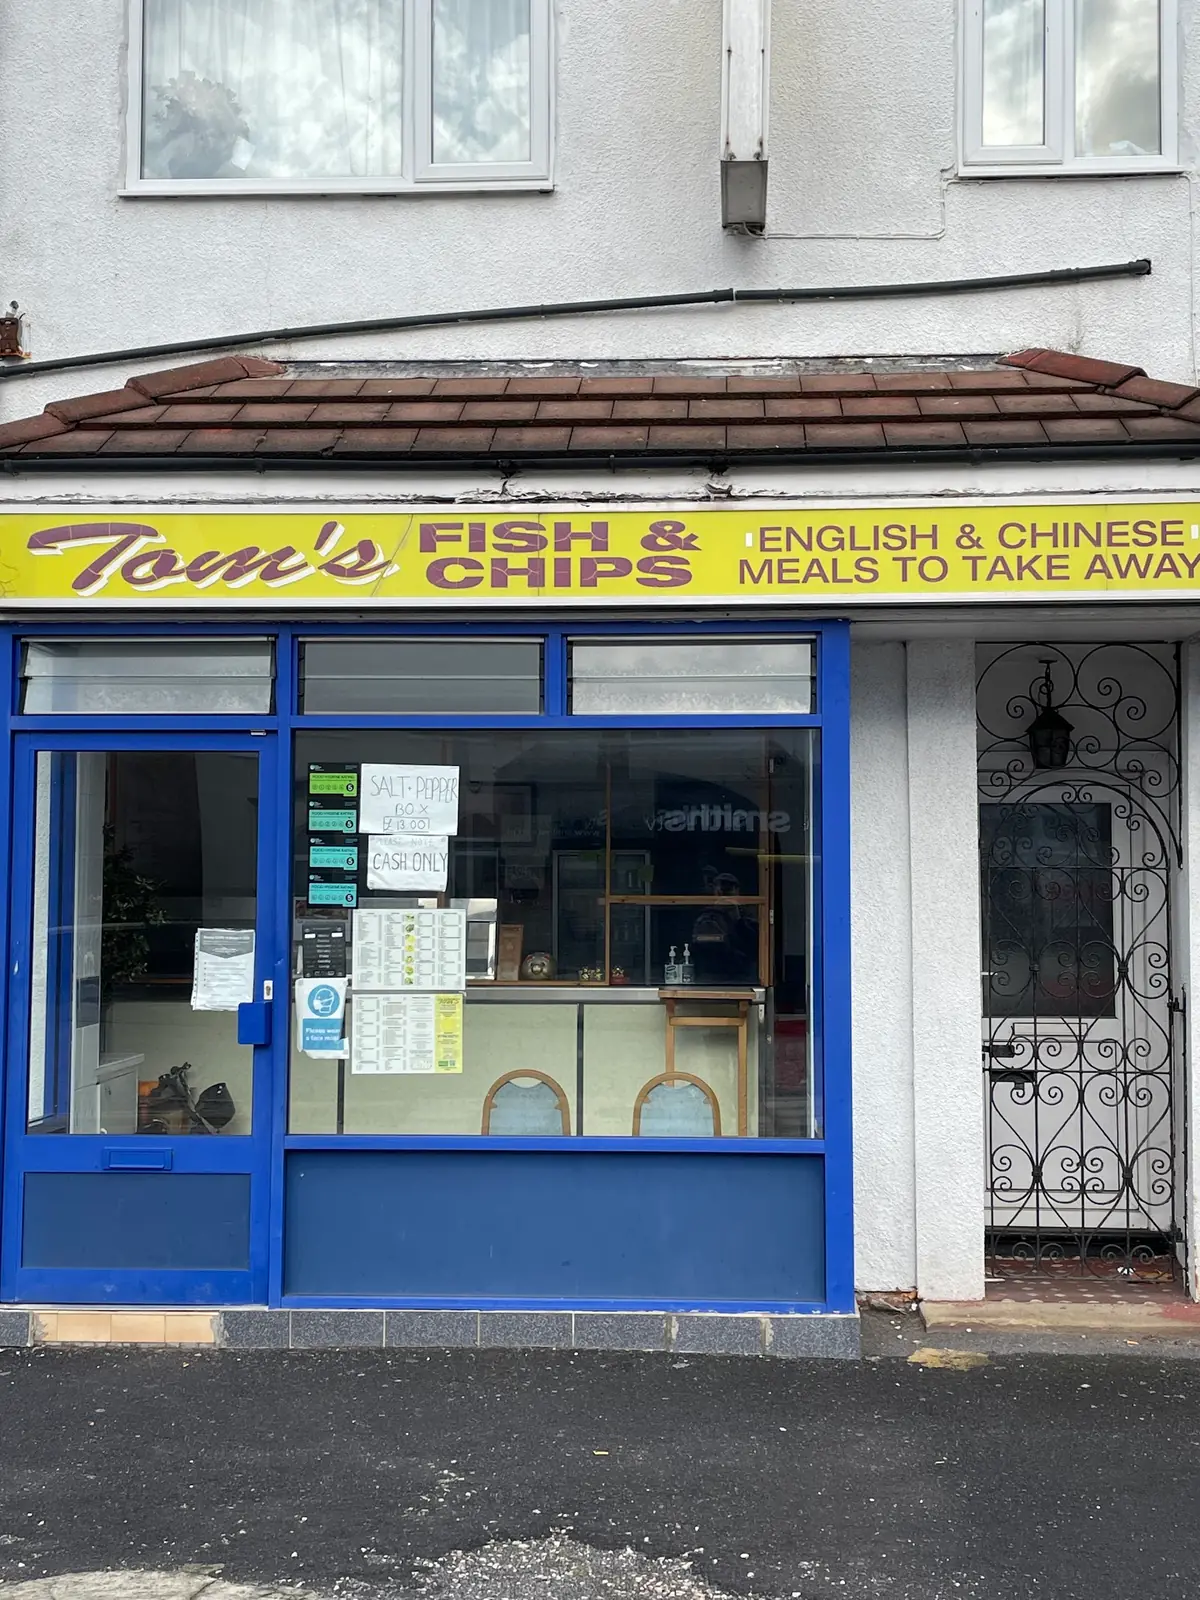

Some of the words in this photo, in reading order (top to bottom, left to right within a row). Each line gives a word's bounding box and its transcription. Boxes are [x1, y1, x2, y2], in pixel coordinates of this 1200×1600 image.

[419, 520, 609, 553] FISH
[640, 520, 703, 552] &
[758, 524, 938, 553] ENGLISH
[955, 523, 985, 550] &
[997, 520, 1185, 549] CHINESE
[27, 521, 397, 596] Tom's
[425, 555, 694, 590] CHIPS
[738, 556, 880, 585] MEALS
[891, 555, 949, 583] TO
[961, 554, 1071, 582] TAKE
[1083, 552, 1200, 581] AWAY
[370, 775, 411, 799] SALT
[416, 775, 458, 804] PEPPER
[395, 802, 429, 816] BOX
[373, 852, 408, 871] CASH
[412, 852, 448, 873] ONLY
